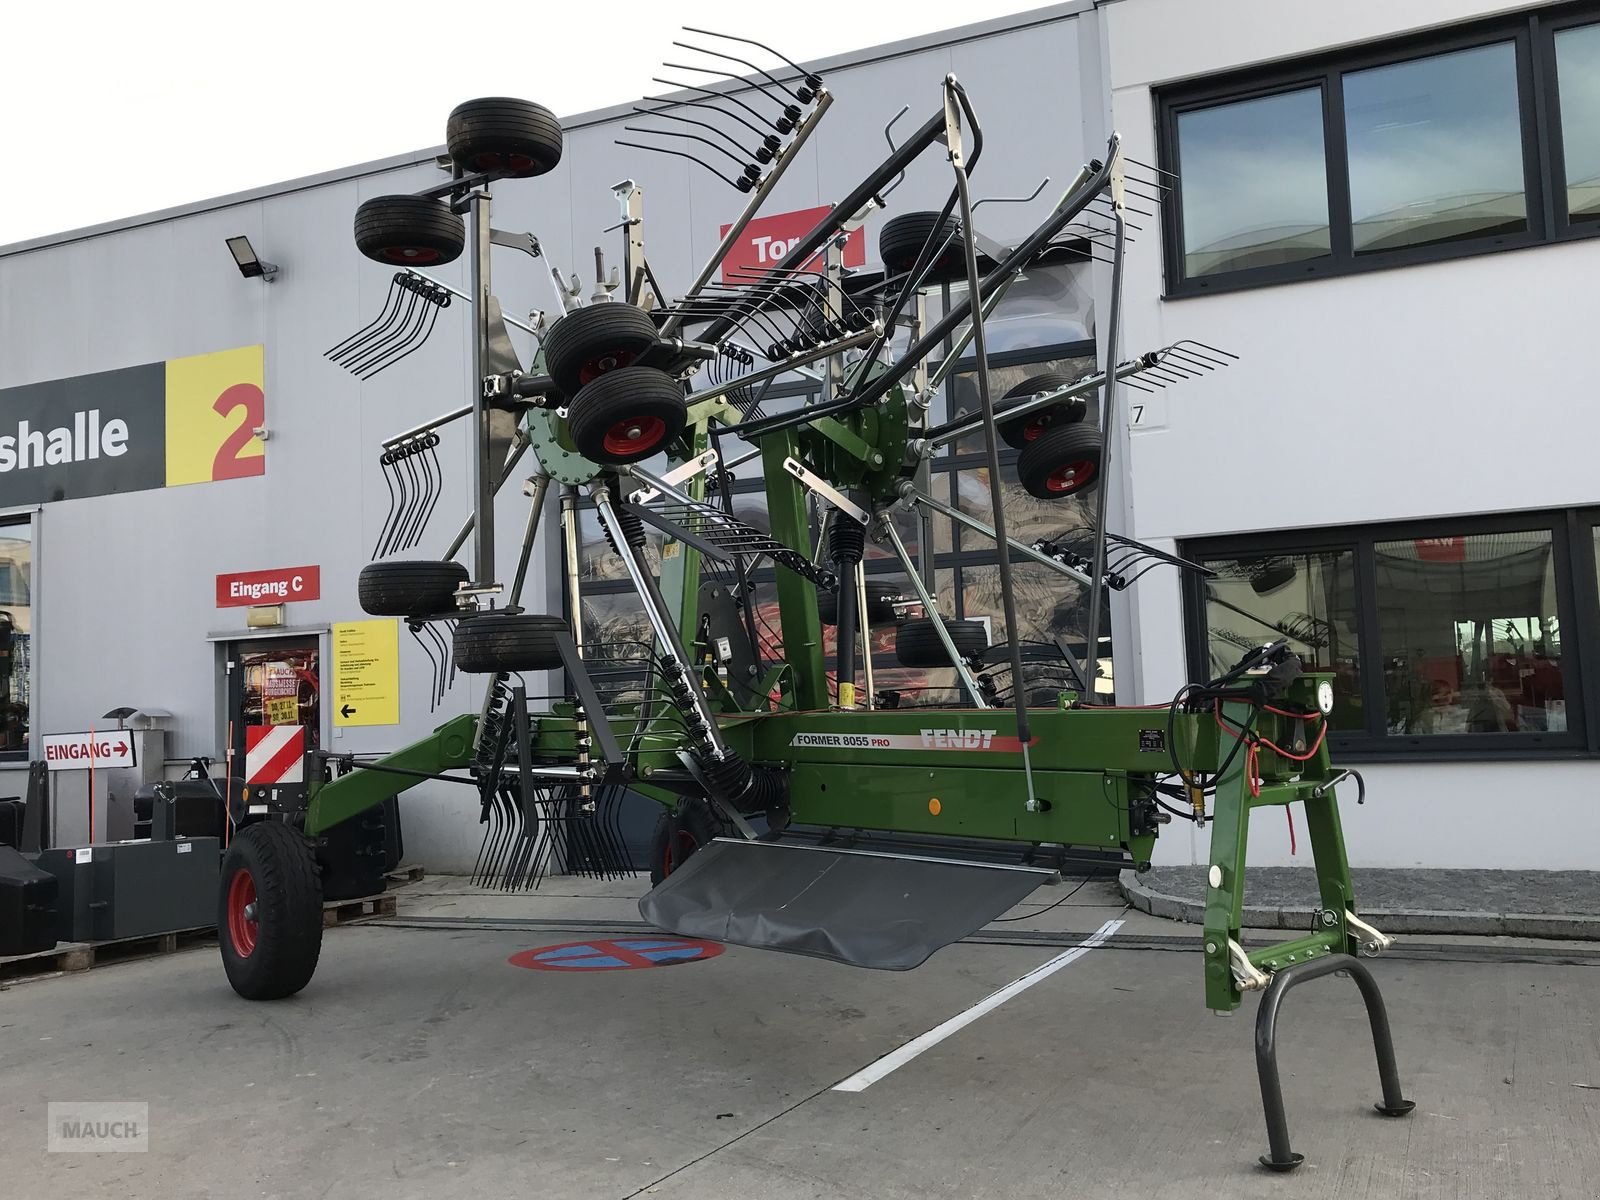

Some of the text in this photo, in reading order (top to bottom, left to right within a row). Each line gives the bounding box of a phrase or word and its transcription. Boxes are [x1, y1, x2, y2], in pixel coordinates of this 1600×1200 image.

[752, 236, 800, 263] Tor
[1133, 405, 1144, 424] 7
[0, 382, 265, 481] shalle 2
[230, 576, 303, 599] Eingang C
[797, 735, 890, 747] FORMER 8055 PRO
[920, 728, 997, 748] FENDT
[46, 742, 111, 761] EINGANG
